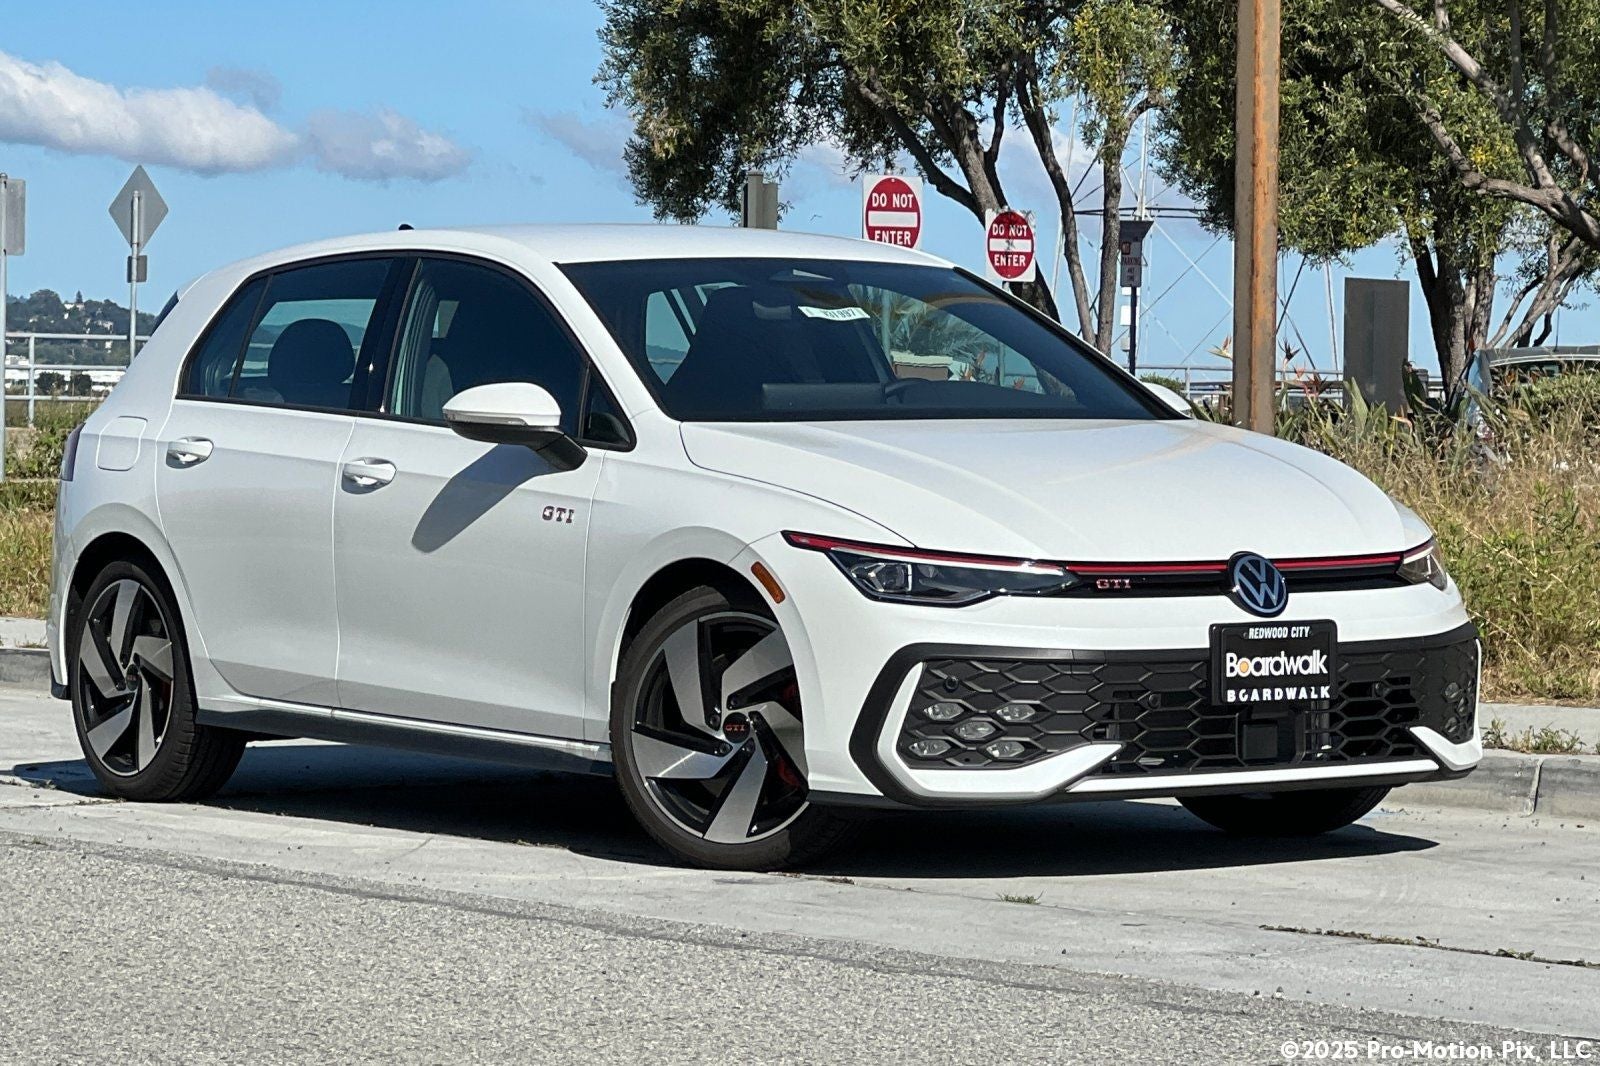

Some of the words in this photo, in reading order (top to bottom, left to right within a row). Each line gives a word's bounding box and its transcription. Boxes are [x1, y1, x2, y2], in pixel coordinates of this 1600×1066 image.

[872, 192, 887, 207] DO
[892, 193, 914, 209] NOT
[992, 223, 1005, 236] DO
[1009, 224, 1028, 237] NOT
[874, 230, 911, 245] ENTER
[994, 254, 1026, 267] ENTER
[542, 505, 575, 524] GTI
[1096, 578, 1132, 589] GTI
[1249, 627, 1288, 639] REDWOOD
[1291, 626, 1310, 638] CITY
[1226, 649, 1328, 678] Boardwalk
[1227, 686, 1330, 703] BOARDWALK
[726, 724, 745, 732] GTI
